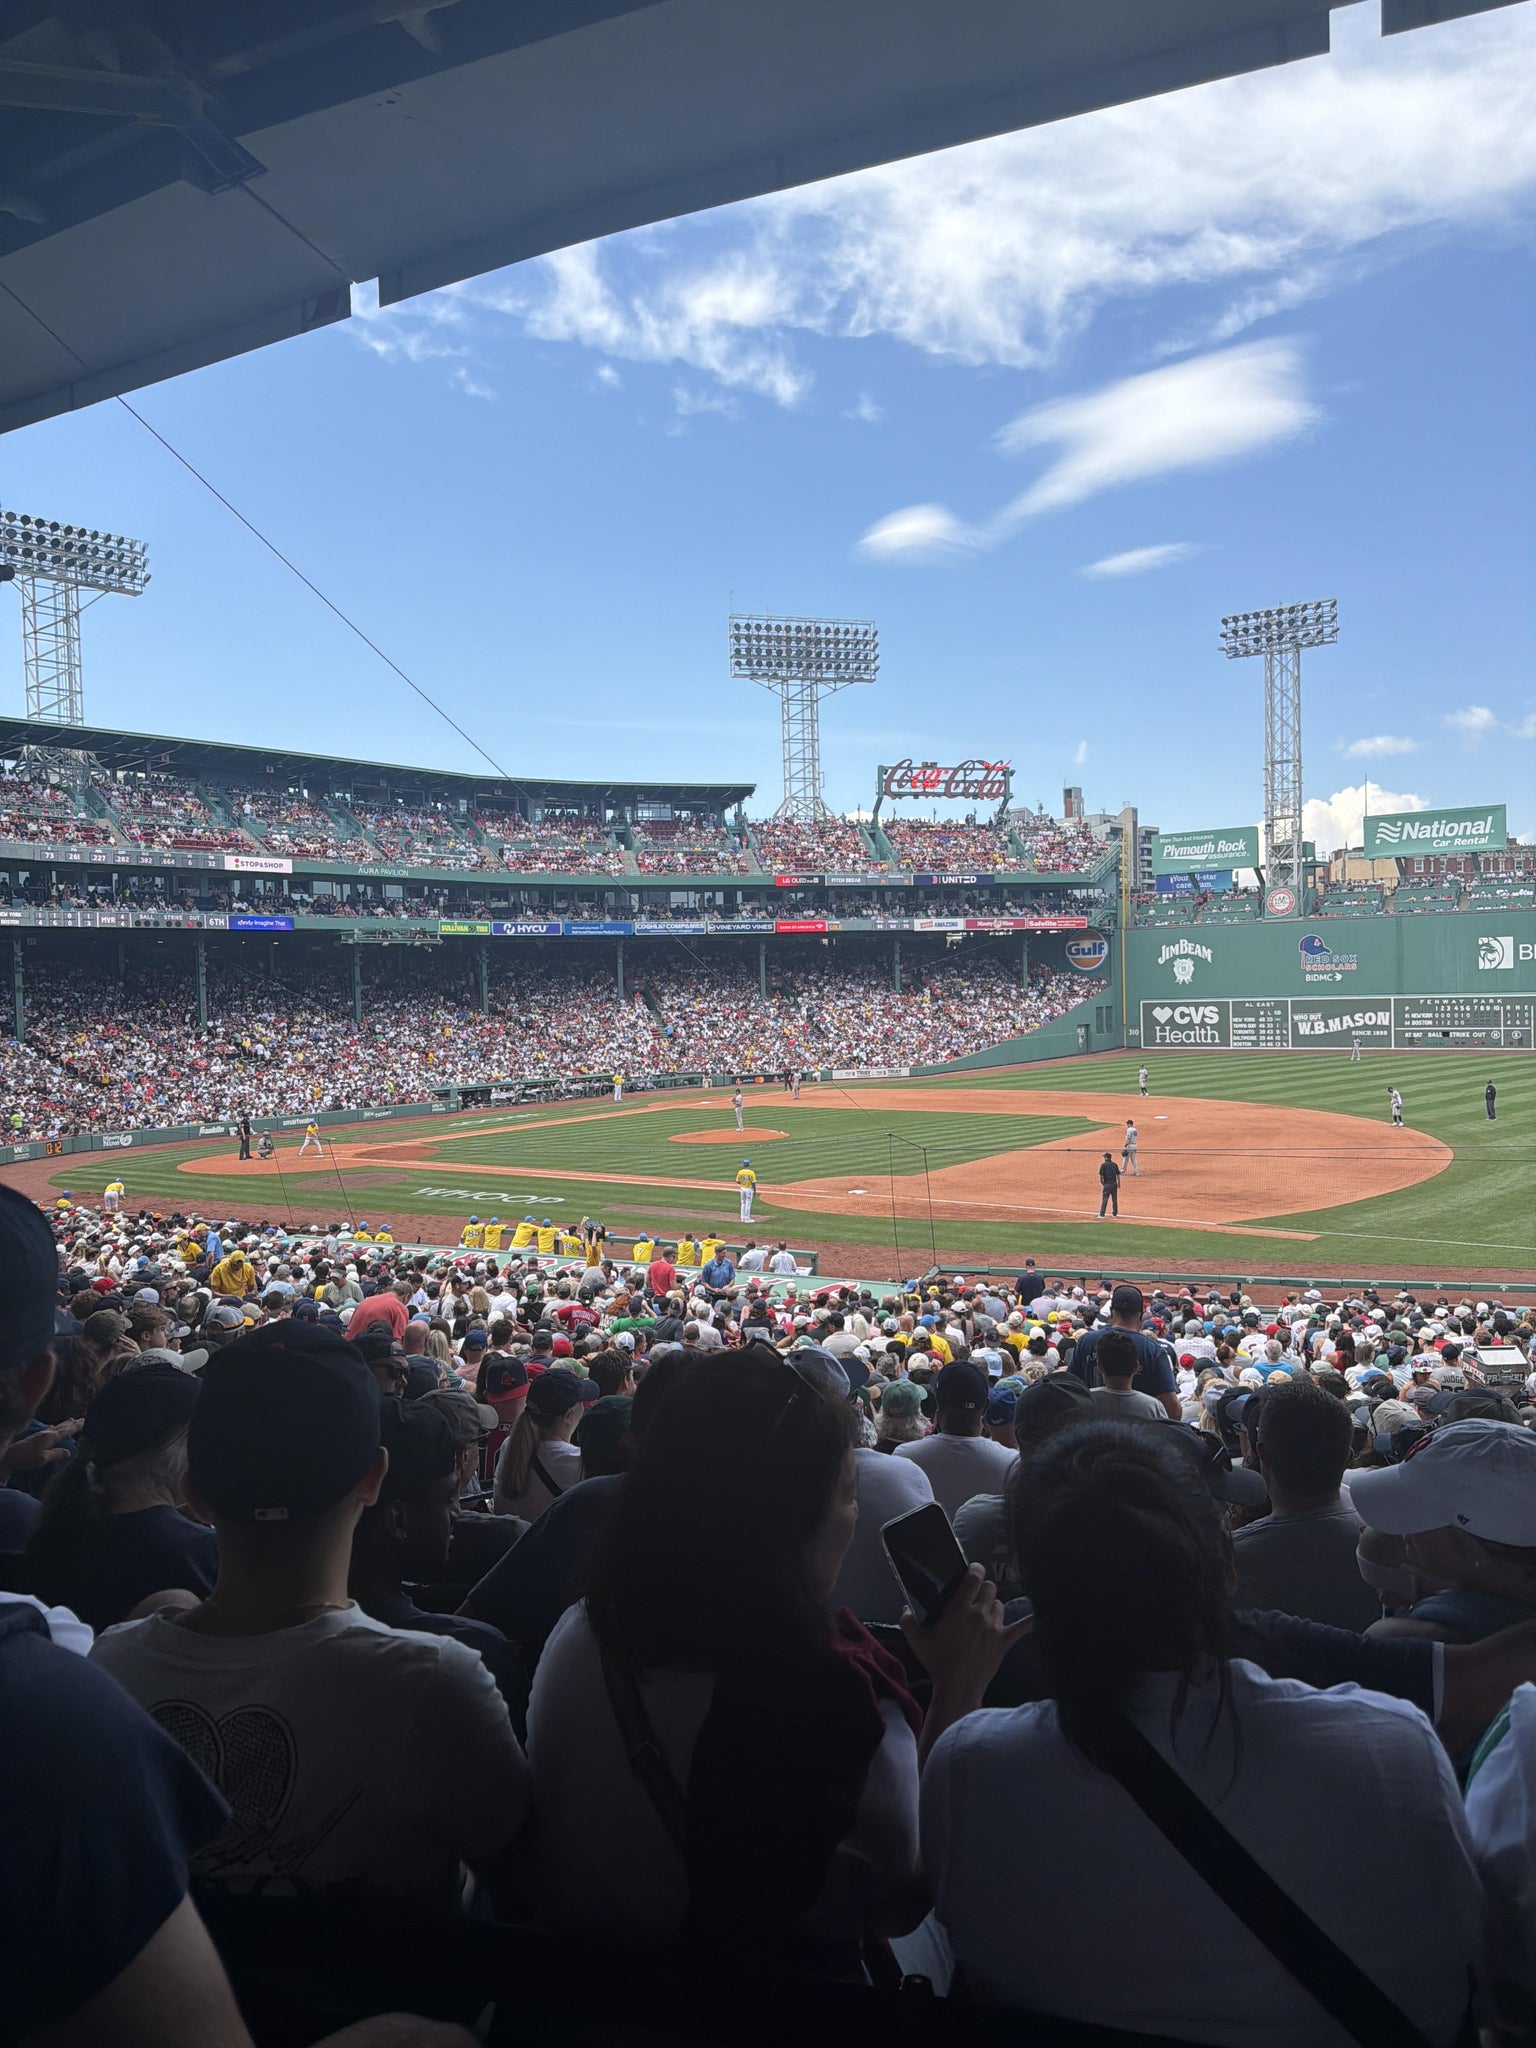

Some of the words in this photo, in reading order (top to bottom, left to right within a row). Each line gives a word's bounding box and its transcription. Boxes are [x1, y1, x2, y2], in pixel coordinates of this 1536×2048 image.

[884, 759, 1011, 800] Coca-Cola
[1163, 841, 1214, 858] Plymouth
[1217, 839, 1246, 852] Rock
[1432, 839, 1450, 848] Car
[1454, 836, 1488, 846] Rental
[1067, 942, 1105, 956] Gulf
[1519, 944, 1536, 960] B
[1306, 954, 1330, 963] RED
[1332, 954, 1357, 963] SOX
[1305, 963, 1357, 971] SCHOLARS
[1174, 1006, 1219, 1024] CVS
[1155, 1026, 1220, 1043] Health
[412, 1187, 565, 1204] WHOOP
